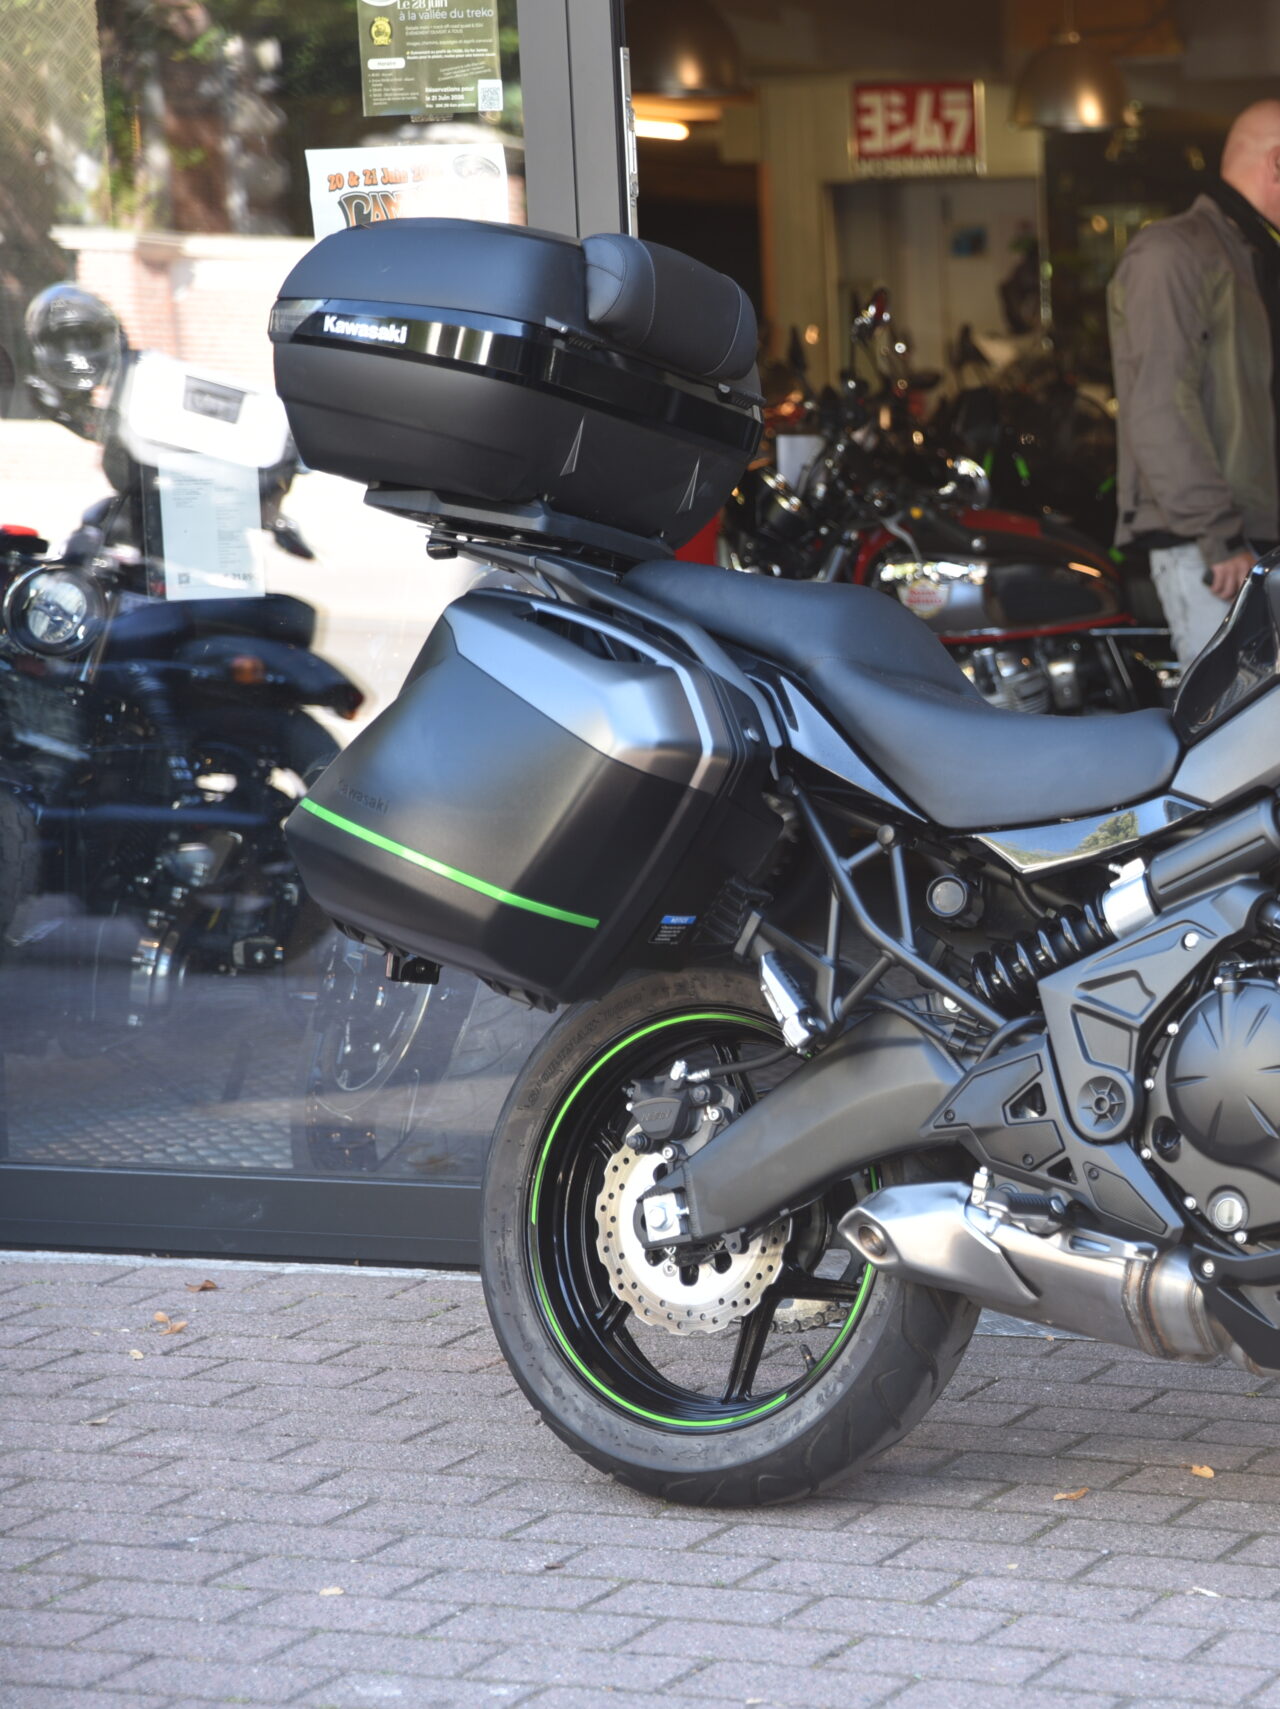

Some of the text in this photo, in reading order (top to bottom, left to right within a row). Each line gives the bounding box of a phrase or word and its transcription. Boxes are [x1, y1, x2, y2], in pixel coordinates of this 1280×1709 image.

[399, 11, 406, 21] à
[407, 10, 417, 20] la
[418, 9, 448, 20] vallée
[449, 8, 464, 18] du
[466, 7, 495, 18] treko
[859, 89, 971, 151] ヨシムラ
[327, 173, 344, 192] 20
[348, 170, 360, 188] &
[363, 168, 378, 187] 21
[381, 167, 408, 185] Juin
[323, 315, 408, 344] Kawasaki
